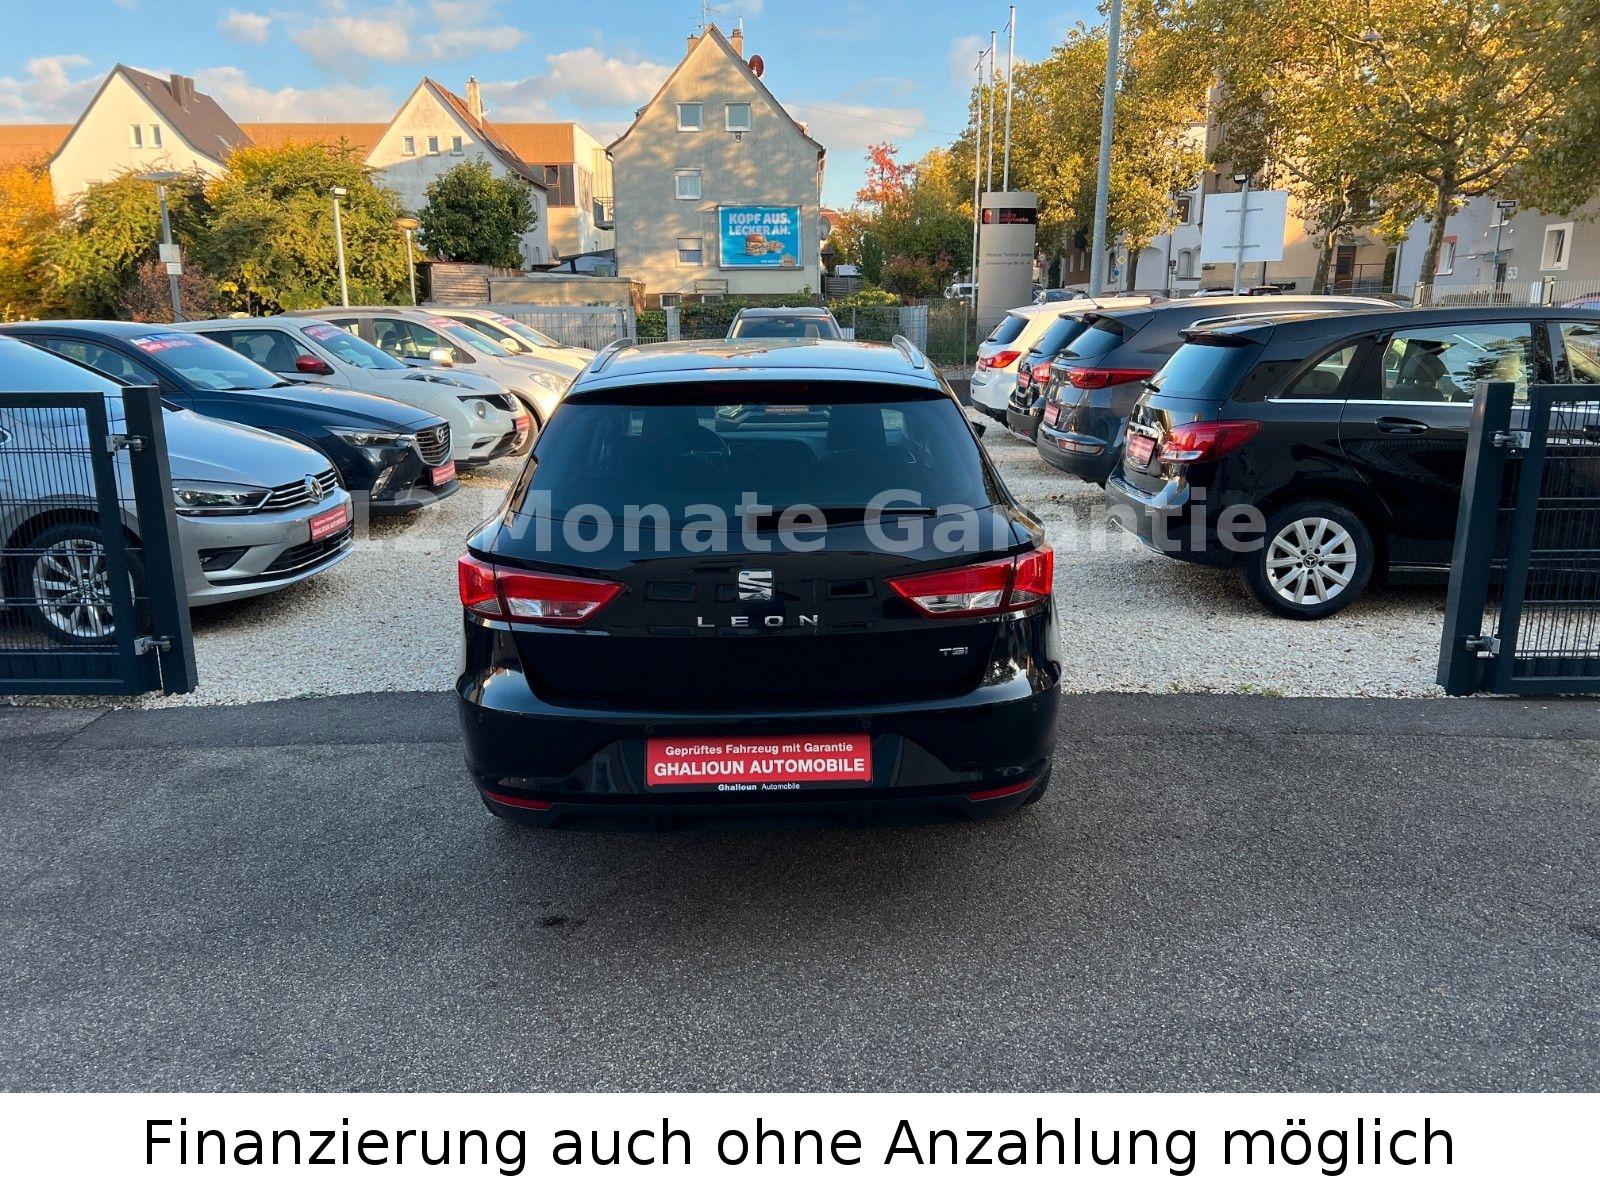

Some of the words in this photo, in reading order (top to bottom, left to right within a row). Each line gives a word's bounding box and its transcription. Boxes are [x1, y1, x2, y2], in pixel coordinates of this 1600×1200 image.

[728, 213, 761, 225] KOPF
[763, 213, 791, 225] AUS.
[728, 225, 770, 236] LECKER
[771, 224, 791, 235] AN.
[1507, 266, 1519, 280] 53
[697, 614, 818, 628] LEON
[939, 646, 968, 656] TSI
[665, 744, 722, 757] Geprüftes
[725, 743, 779, 755] Fahrzeug
[782, 743, 801, 753] mit
[803, 741, 853, 752] Garantie
[653, 760, 745, 777] GHALIOUN
[749, 757, 865, 774] AUTOMOBILE
[717, 783, 757, 791] Ghalioun
[761, 782, 800, 791] Automobile
